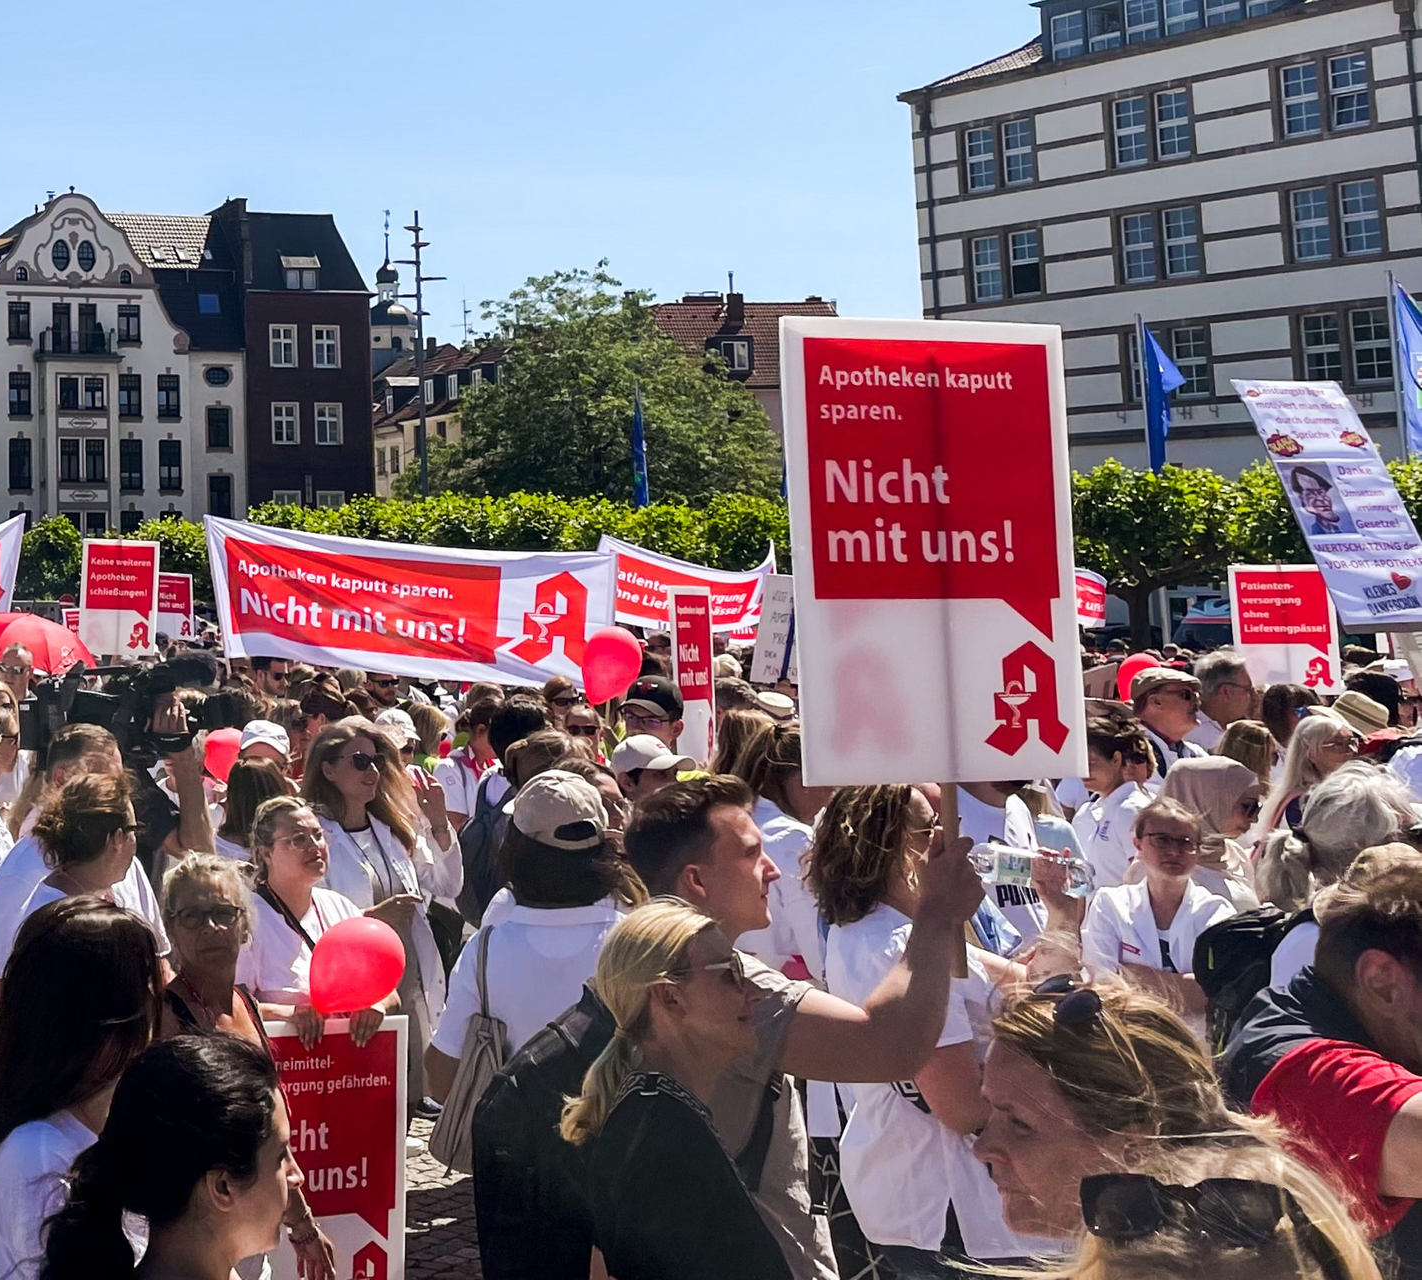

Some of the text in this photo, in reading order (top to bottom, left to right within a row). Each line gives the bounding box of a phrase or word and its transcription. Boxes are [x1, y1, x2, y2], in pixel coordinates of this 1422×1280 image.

[819, 364, 1013, 394] Apotheken kaputt
[820, 402, 903, 424] sparen.
[1337, 465, 1372, 476] Danke
[825, 458, 951, 504] Nicht
[1356, 518, 1400, 529] Gesetze!
[827, 518, 1016, 564] mit uns!
[91, 557, 152, 567] Keine weiteren
[90, 572, 139, 582] Apotheken-
[238, 559, 454, 601] Apotheken kaputt sparen.
[1240, 582, 1294, 591] Patienten-
[89, 588, 148, 599] schließungen!
[1362, 583, 1398, 600] KLEINES
[1241, 597, 1302, 607] versorgung
[241, 587, 466, 644] Nicht mit uns!
[1243, 610, 1270, 619] ohne
[679, 643, 700, 662] Nicht
[680, 667, 695, 686] mit
[327, 1073, 391, 1094] gefährden.
[308, 1157, 368, 1193] uns!
